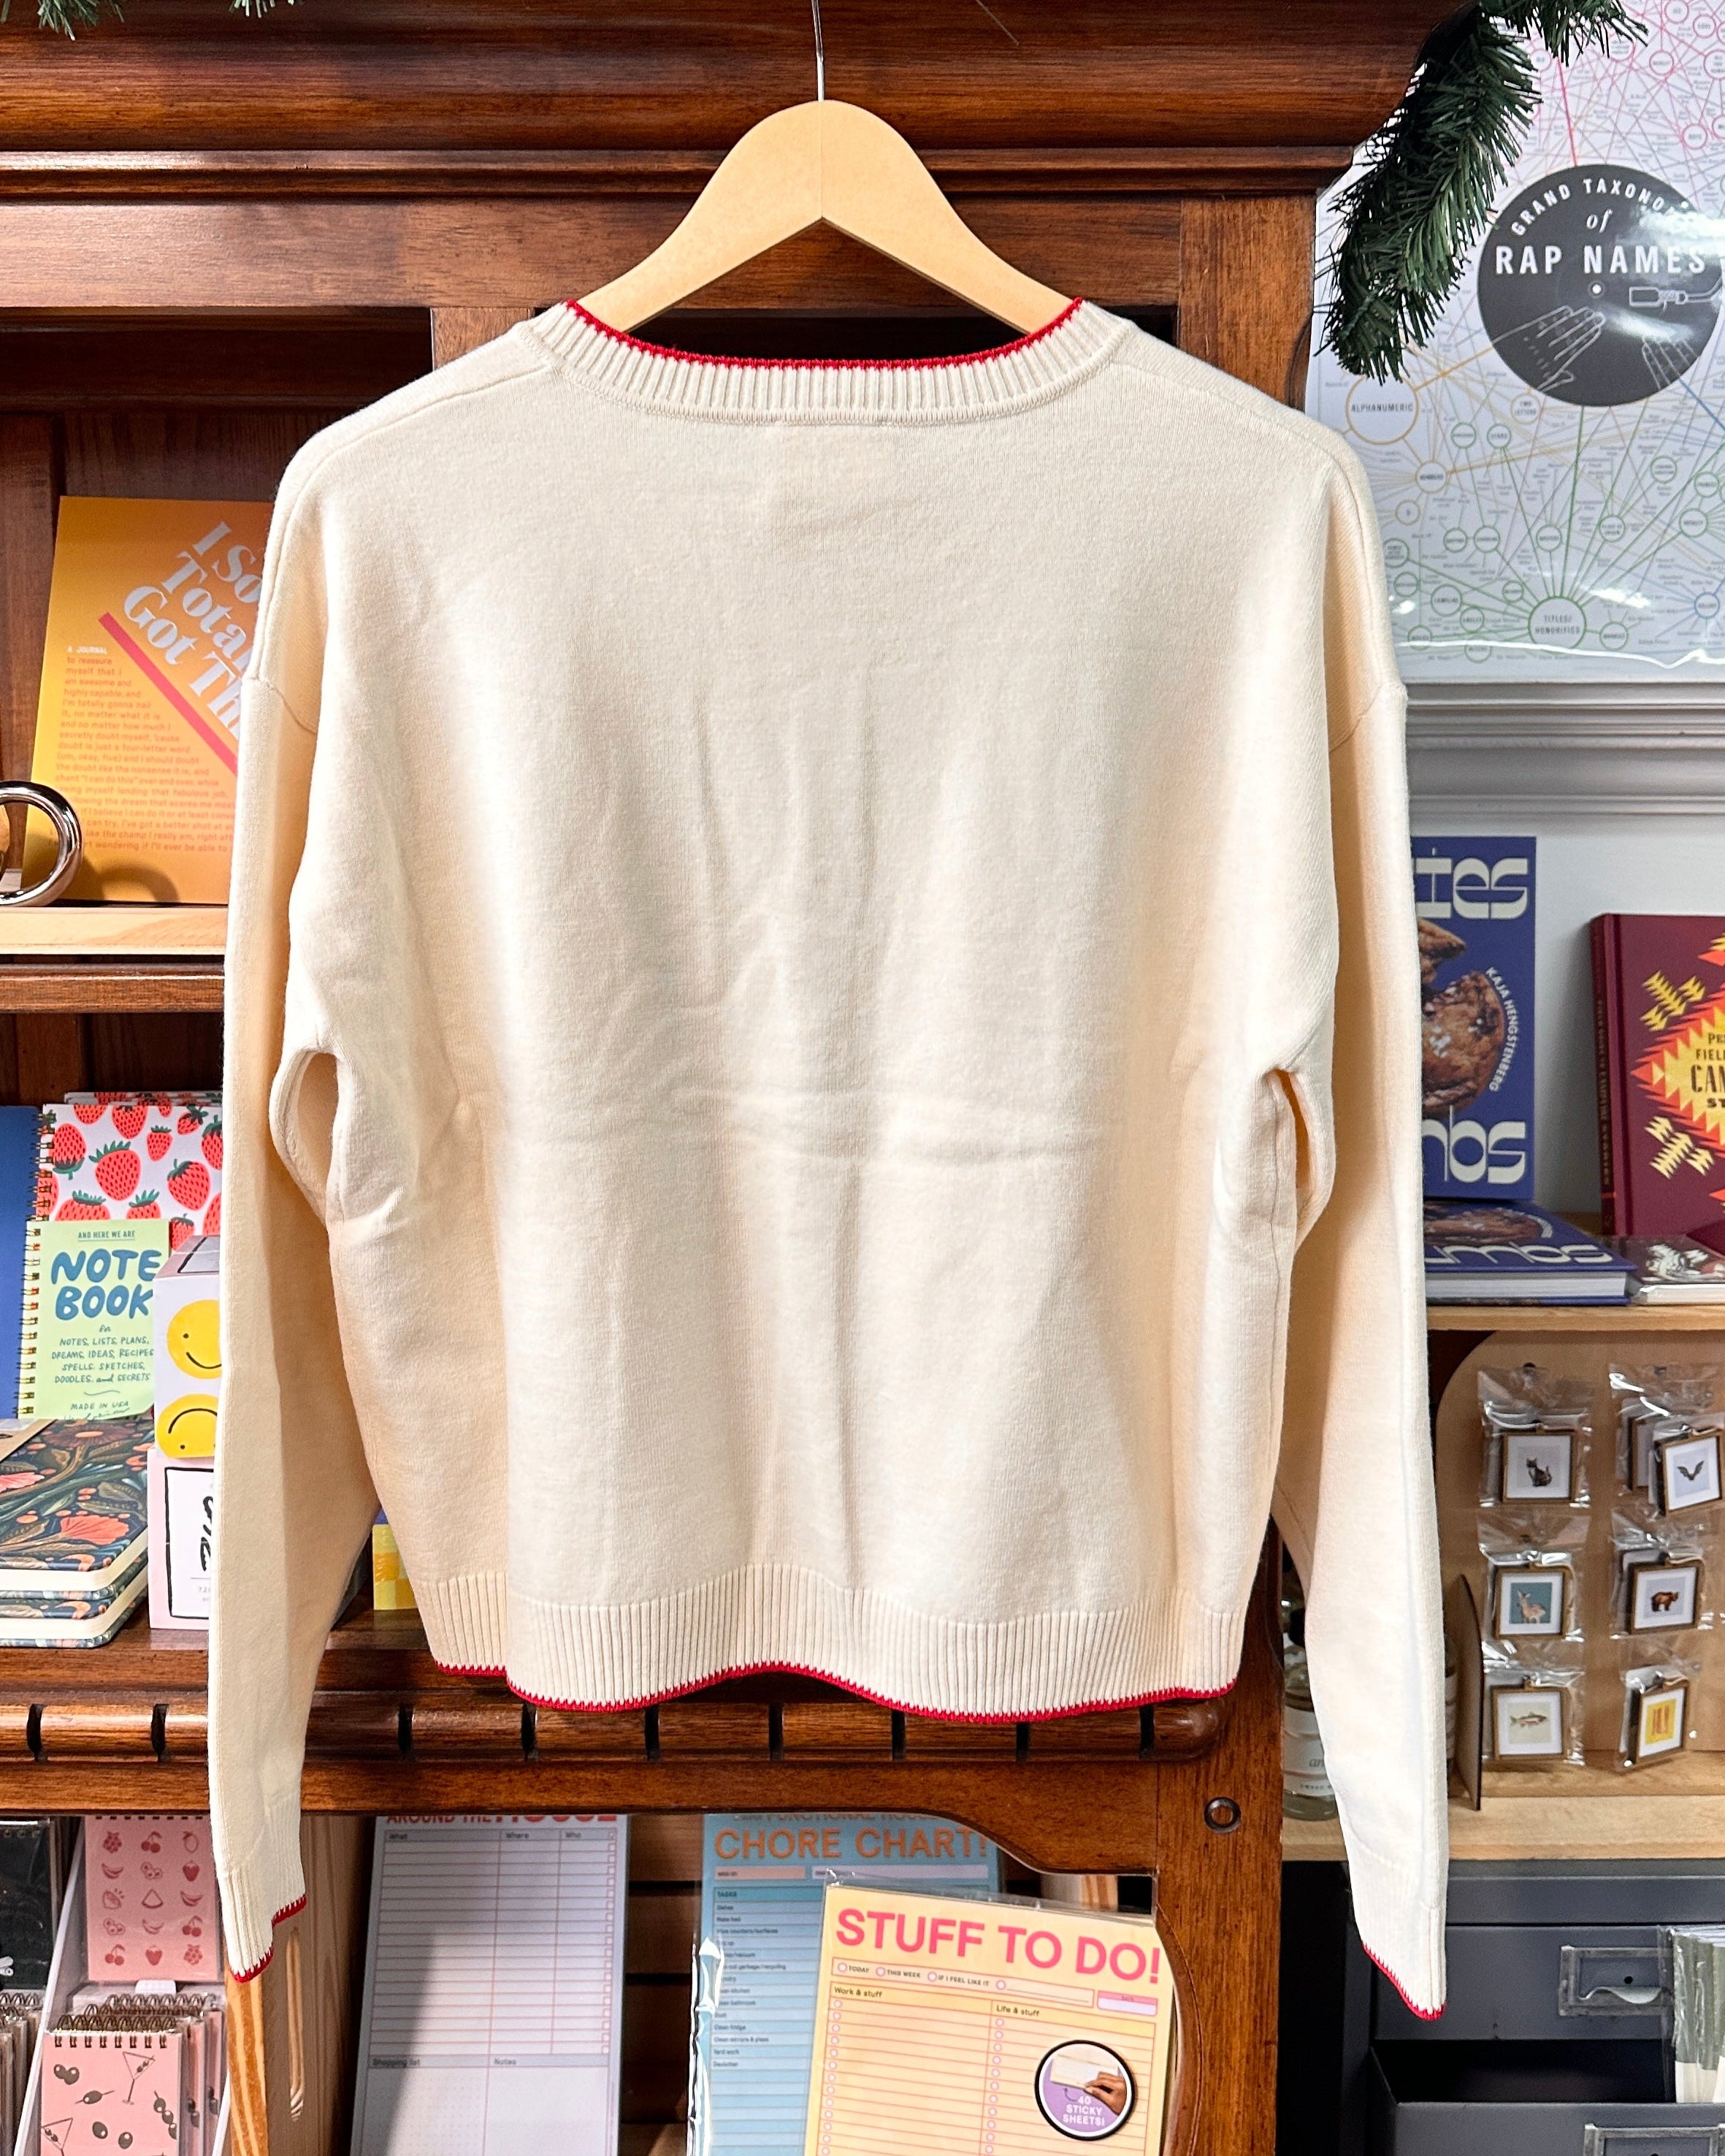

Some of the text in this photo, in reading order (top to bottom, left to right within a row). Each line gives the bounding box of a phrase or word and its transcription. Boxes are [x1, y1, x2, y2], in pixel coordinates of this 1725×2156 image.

[1511, 177, 1675, 236] GRAND TAXONO
[1586, 208, 1613, 234] of
[1495, 244, 1705, 275] RAP NAMES
[1351, 403, 1413, 413] ALPHANUMERIC
[192, 521, 232, 557] I
[123, 585, 199, 666] Got
[76, 646, 108, 654] JOURNAL
[188, 650, 243, 742] Th
[1415, 846, 1528, 920] ies
[1485, 966, 1518, 1092] KAJA HENGSTENBERG
[1708, 1032, 1725, 1045] PE
[1696, 1049, 1725, 1060] FIEL
[51, 1248, 163, 1285] NOTE
[56, 1284, 154, 1320] BOOK
[99, 1324, 111, 1332] for
[60, 1337, 89, 1346] NOTES,
[88, 1350, 115, 1359] IDEAS,
[96, 1373, 114, 1383] and
[118, 1373, 151, 1382] SECRETS
[71, 1400, 129, 1410] MADE IN USA
[714, 1827, 988, 1859] CHORE CHART!
[835, 1908, 1160, 1984] STUFF TO DO!
[849, 1965, 870, 1973] TODAY
[903, 1970, 921, 1979] WEEK
[949, 1976, 966, 1984] FEEL
[967, 1978, 982, 1986] LIKE
[834, 1986, 854, 1995] Work
[863, 1989, 883, 1998] stuff
[996, 2004, 1011, 2014] Life
[1020, 2008, 1040, 2017] stuff
[372, 2057, 420, 2068] Shopping list
[494, 2057, 517, 2065] Notes
[1077, 2095, 1092, 2105] 40
[1066, 2103, 1103, 2116] STICKY
[1063, 2114, 1105, 2127] SHEETS!
